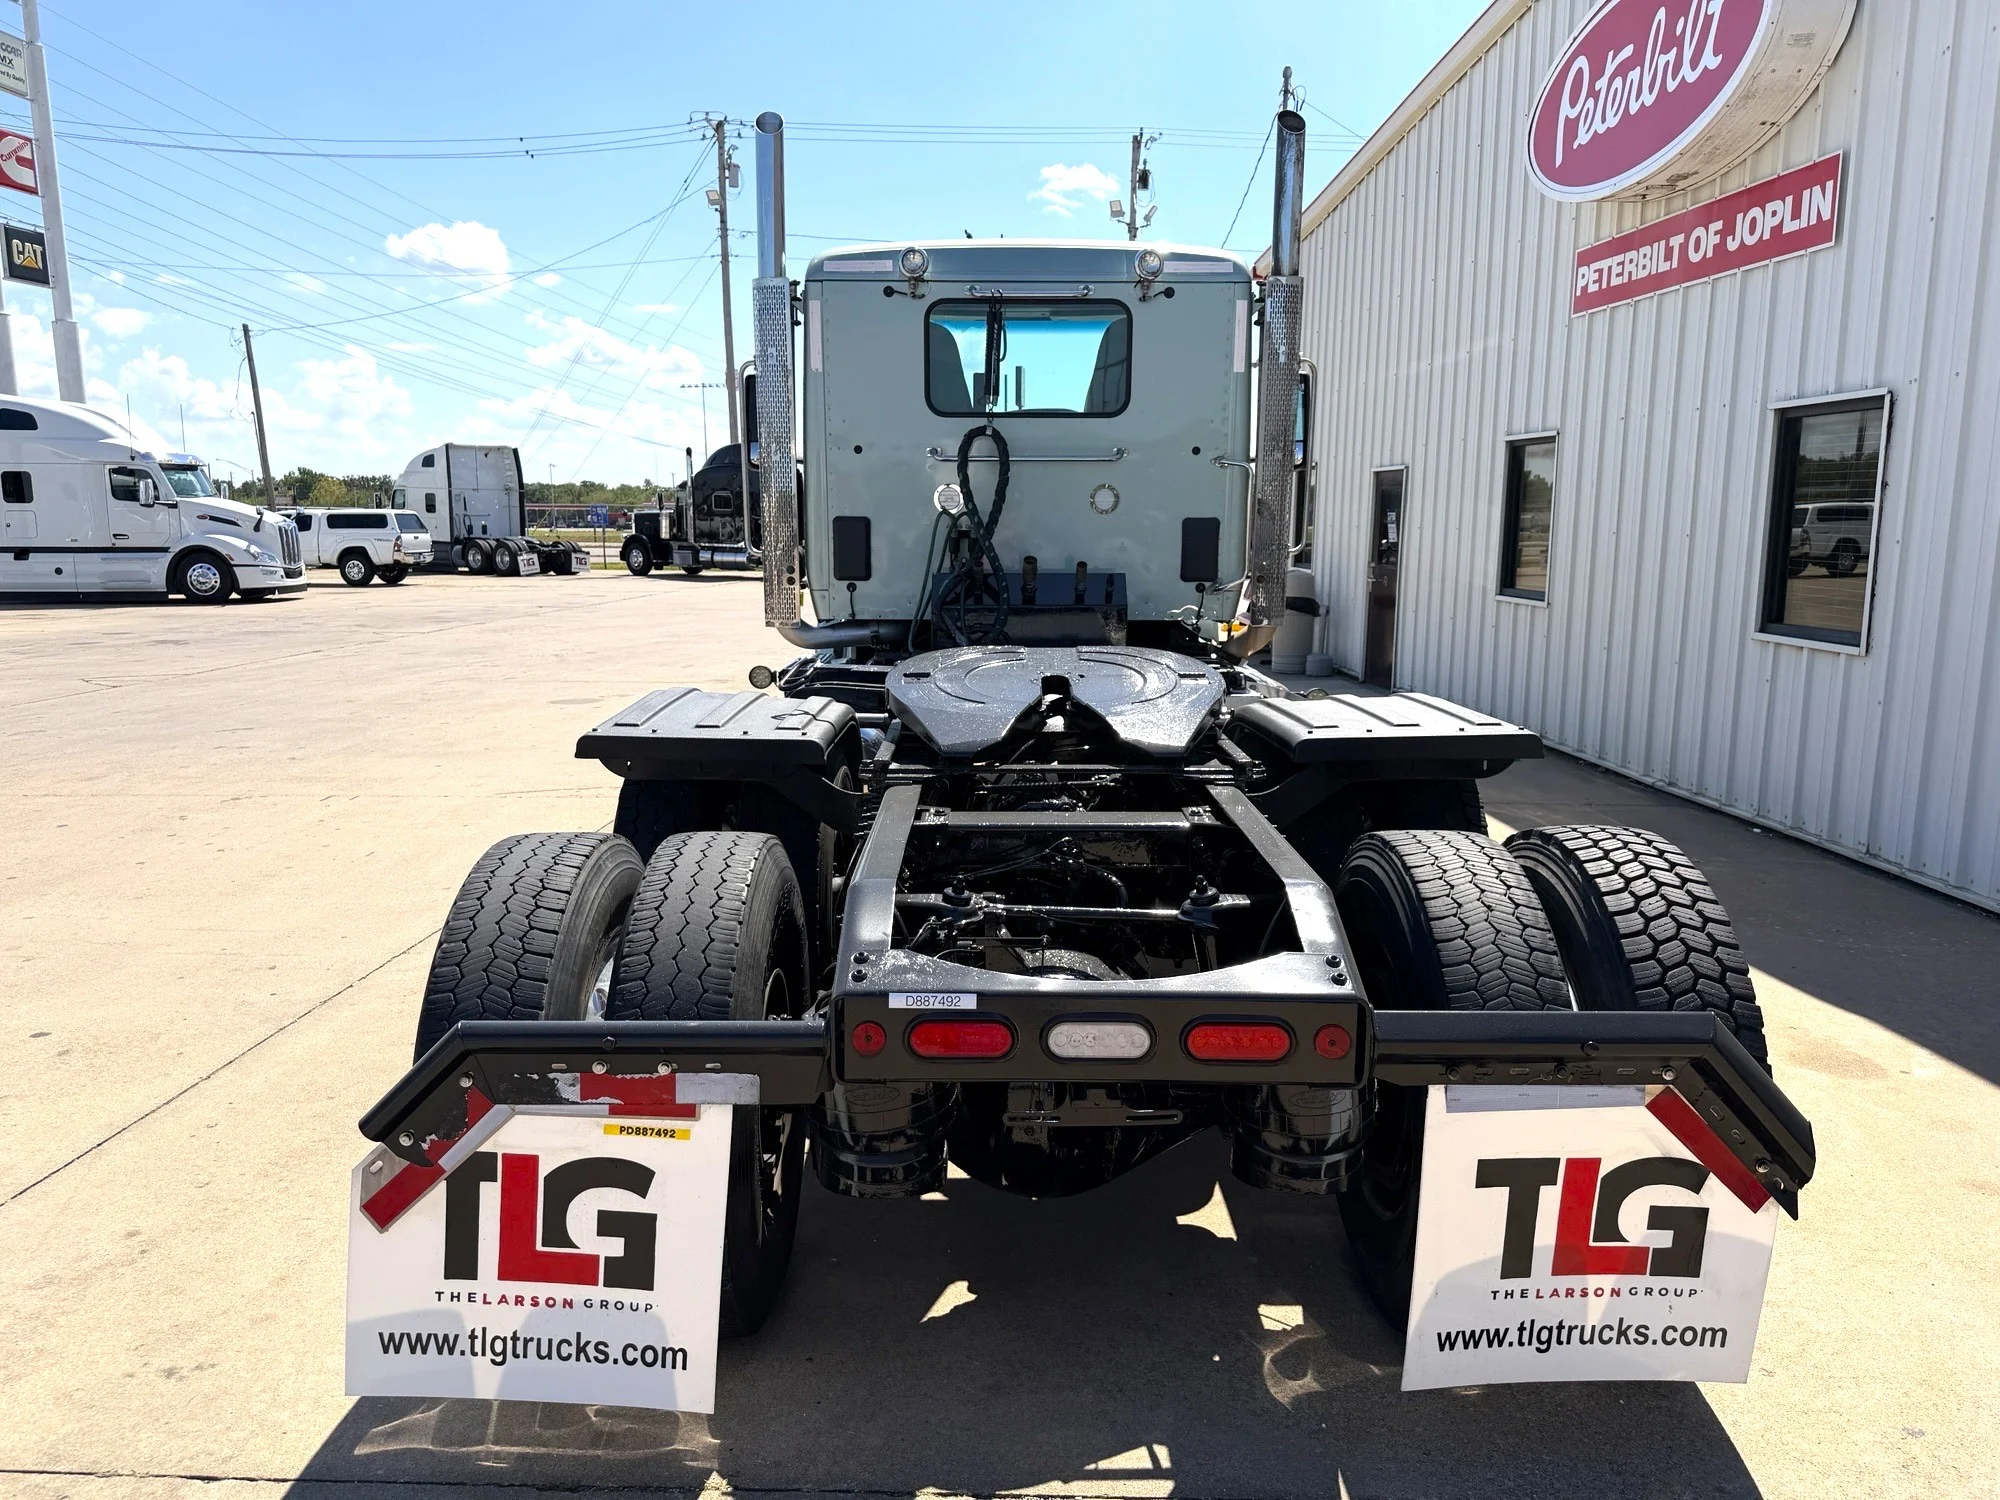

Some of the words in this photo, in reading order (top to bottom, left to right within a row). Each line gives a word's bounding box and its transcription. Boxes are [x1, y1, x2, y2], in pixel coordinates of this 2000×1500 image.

[0, 42, 22, 58] CCAR
[1555, 0, 1725, 169] Peterbilt
[0, 141, 29, 162] Cummins
[1575, 234, 1685, 296] PETERBILT
[1687, 219, 1723, 263] OF
[1726, 180, 1834, 252] JOPLIN
[12, 239, 43, 270] CAT
[905, 995, 961, 1007] D887492
[619, 1125, 677, 1139] PD887492
[443, 1151, 657, 1291] TLG
[1475, 1156, 1711, 1280] TLG
[583, 1297, 655, 1313] GROUP
[1628, 1286, 1698, 1298] GROUP
[378, 1326, 688, 1371] www.tlgtrucks.com
[1436, 1317, 1728, 1354] www.tlgtrucks.com
